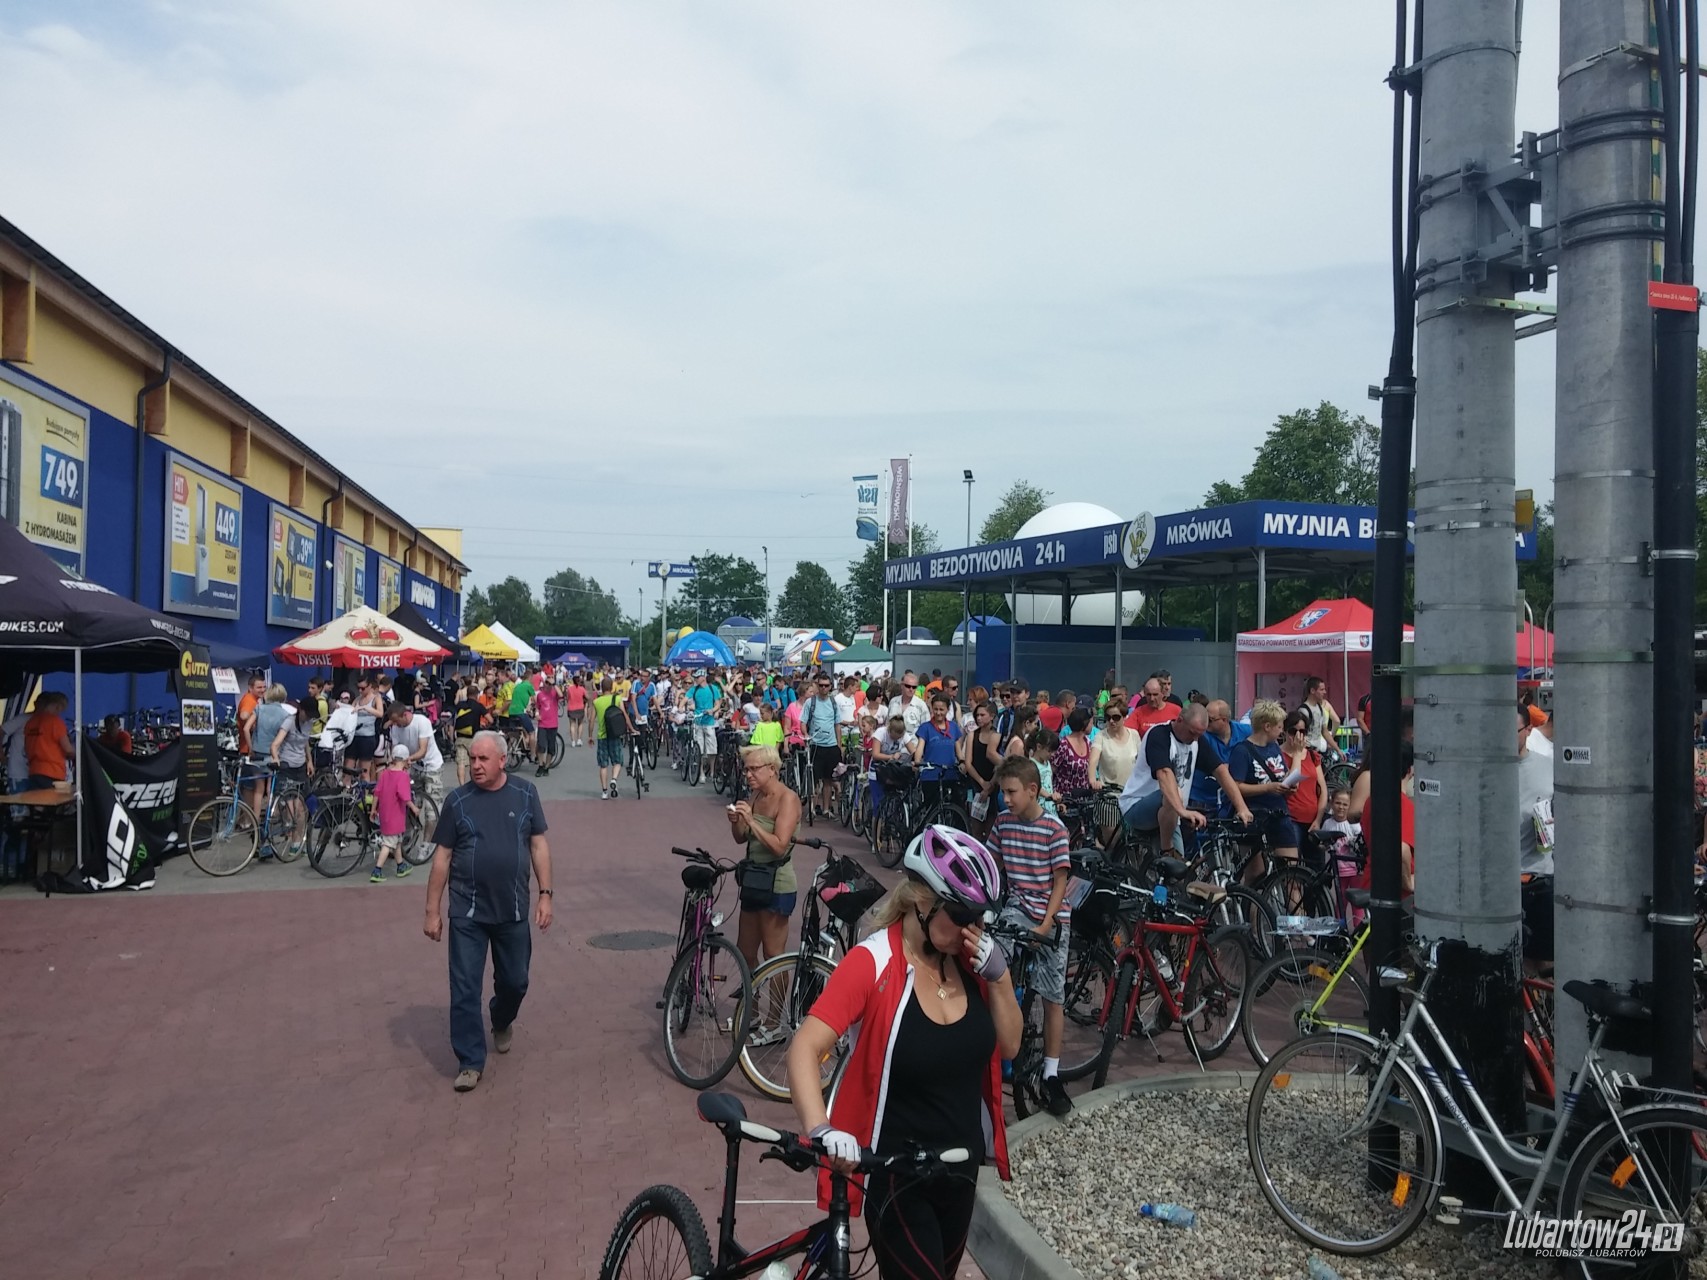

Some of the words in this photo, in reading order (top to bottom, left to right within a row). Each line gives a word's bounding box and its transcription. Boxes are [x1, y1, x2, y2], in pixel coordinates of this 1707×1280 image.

[56, 511, 77, 527] KABINA
[1166, 516, 1233, 546] MRÓWKA
[1263, 513, 1351, 539] MYJNIA
[25, 521, 30, 534] Z
[31, 522, 77, 545] HYDROMASAŻEM
[1103, 529, 1118, 560] psb
[885, 561, 922, 585] MYJNIA
[930, 546, 1024, 579] BEZDOTYKOWA
[1238, 639, 1265, 647] STAROSTWO
[1266, 639, 1297, 647] POWIATOWE
[1298, 638, 1303, 646] W
[1304, 638, 1342, 646] LUBARTOWIE
[296, 653, 332, 666] TYSKIE
[359, 654, 400, 667] TYSKIE
[1444, 1096, 1471, 1133] HERCULES
